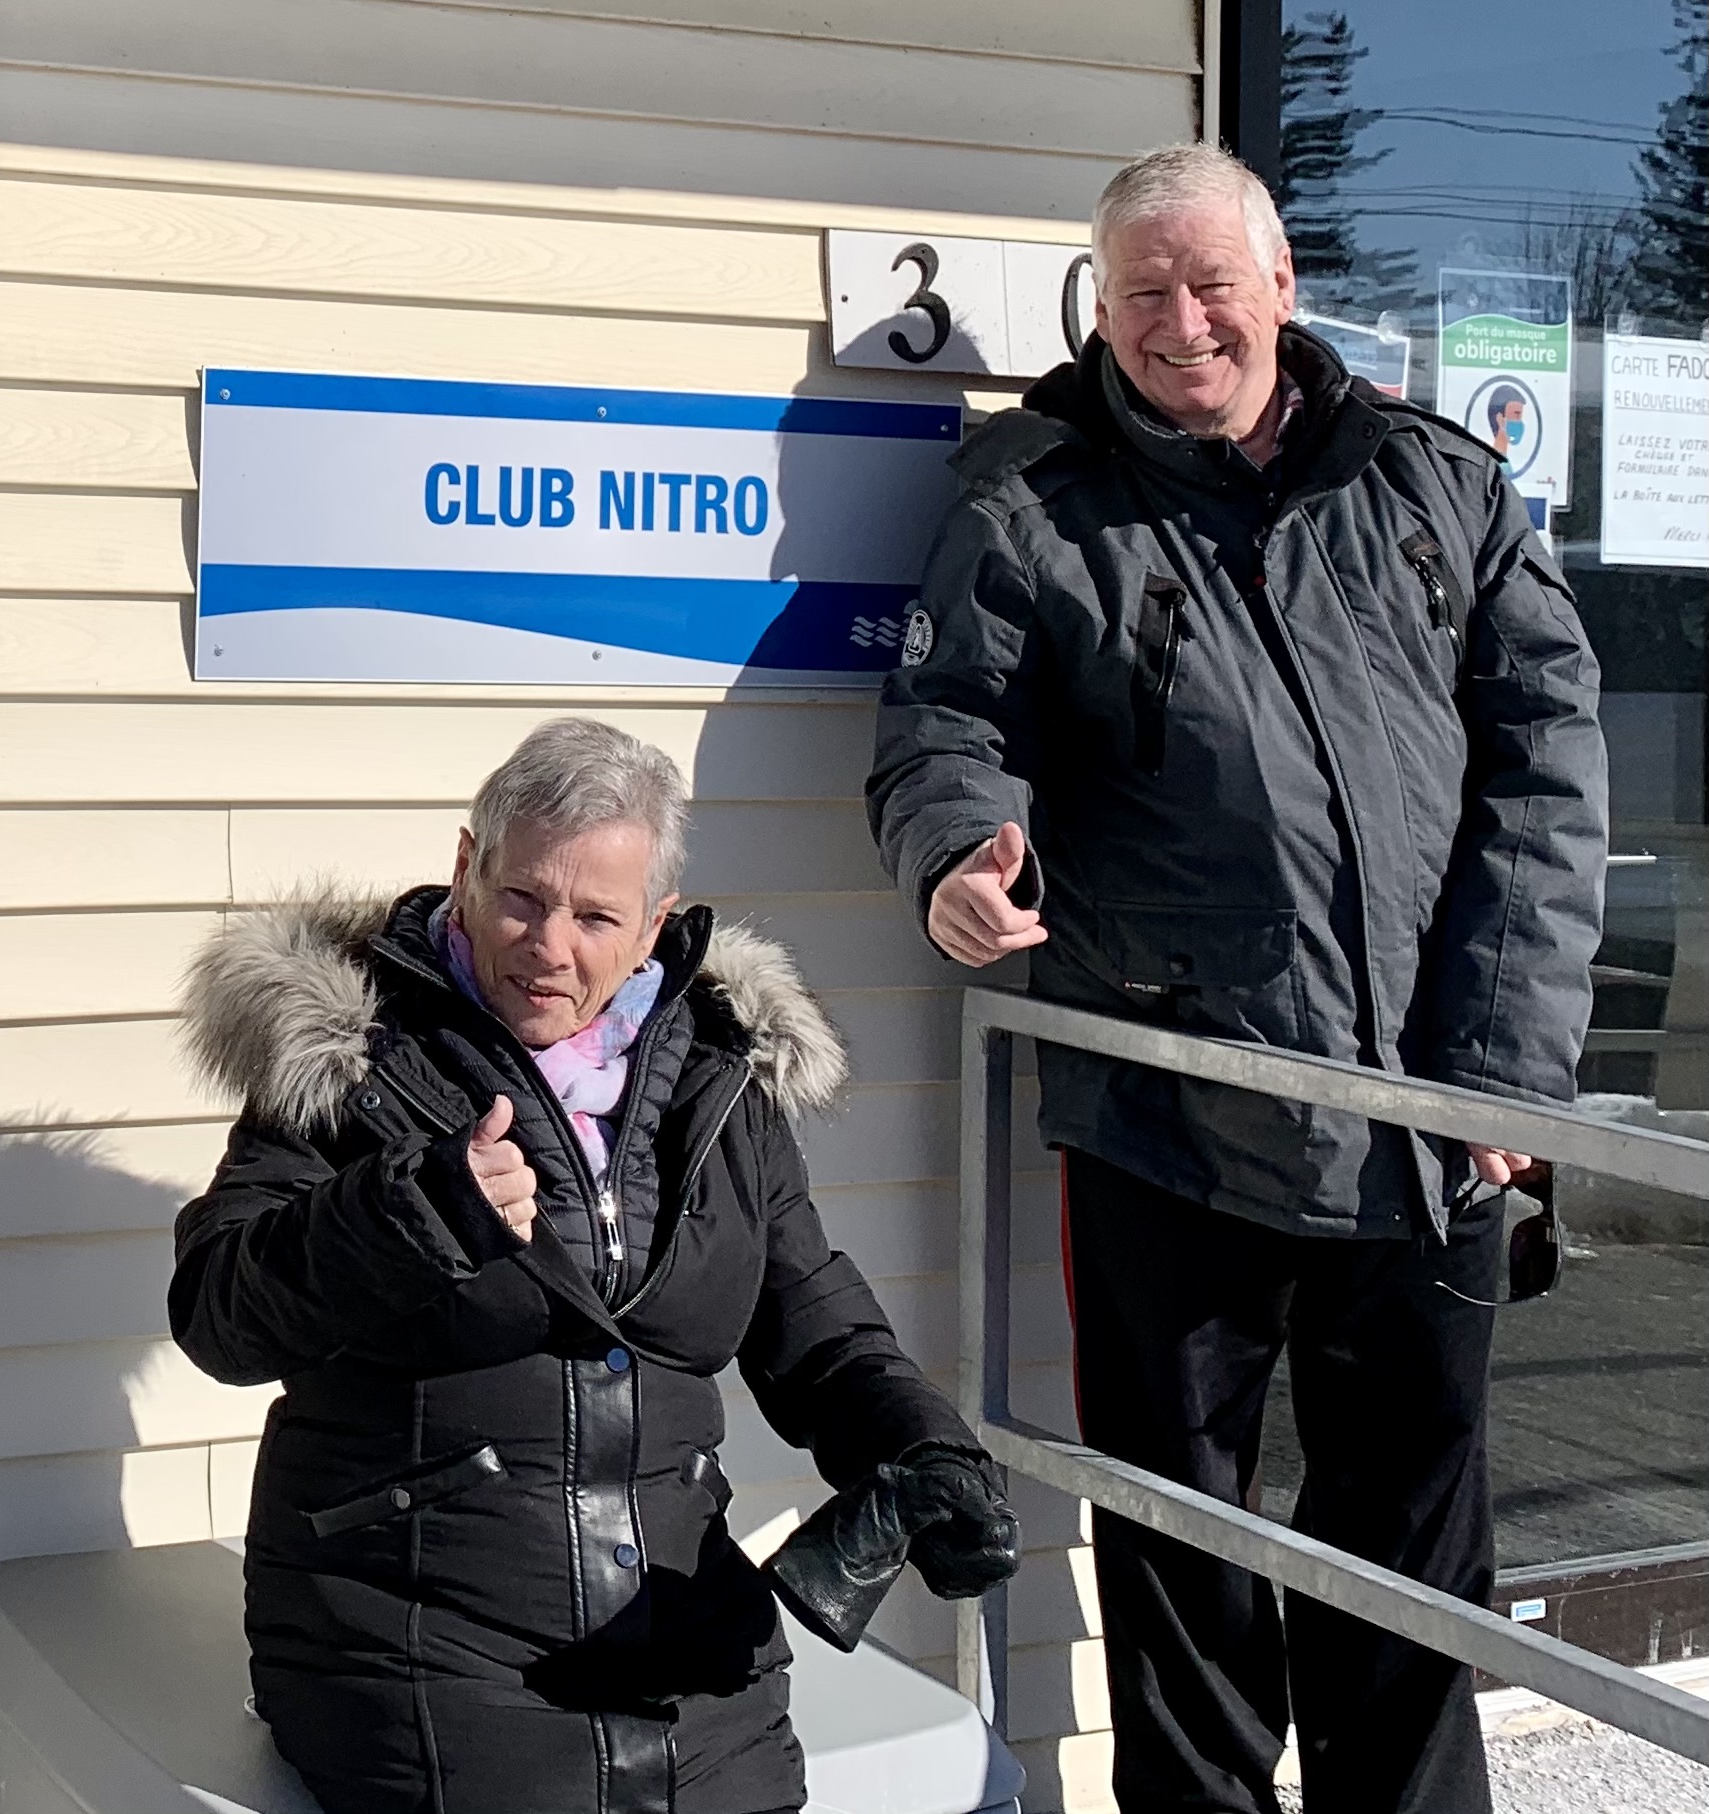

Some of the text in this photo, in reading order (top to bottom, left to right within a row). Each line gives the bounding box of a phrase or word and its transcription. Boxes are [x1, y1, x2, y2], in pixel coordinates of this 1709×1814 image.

[888, 242, 951, 364] 3
[1465, 323, 1547, 342] Port du masque
[1454, 338, 1558, 366] obligatoire
[1611, 355, 1660, 377] CARTE
[1614, 389, 1709, 414] RENOUVELLEME
[1618, 434, 1672, 449] LAISSEZ
[1681, 453, 1695, 462] ET
[1617, 461, 1680, 477] FORMULAIRE
[424, 462, 769, 536] CLUB NITRO
[1613, 490, 1629, 501] LA
